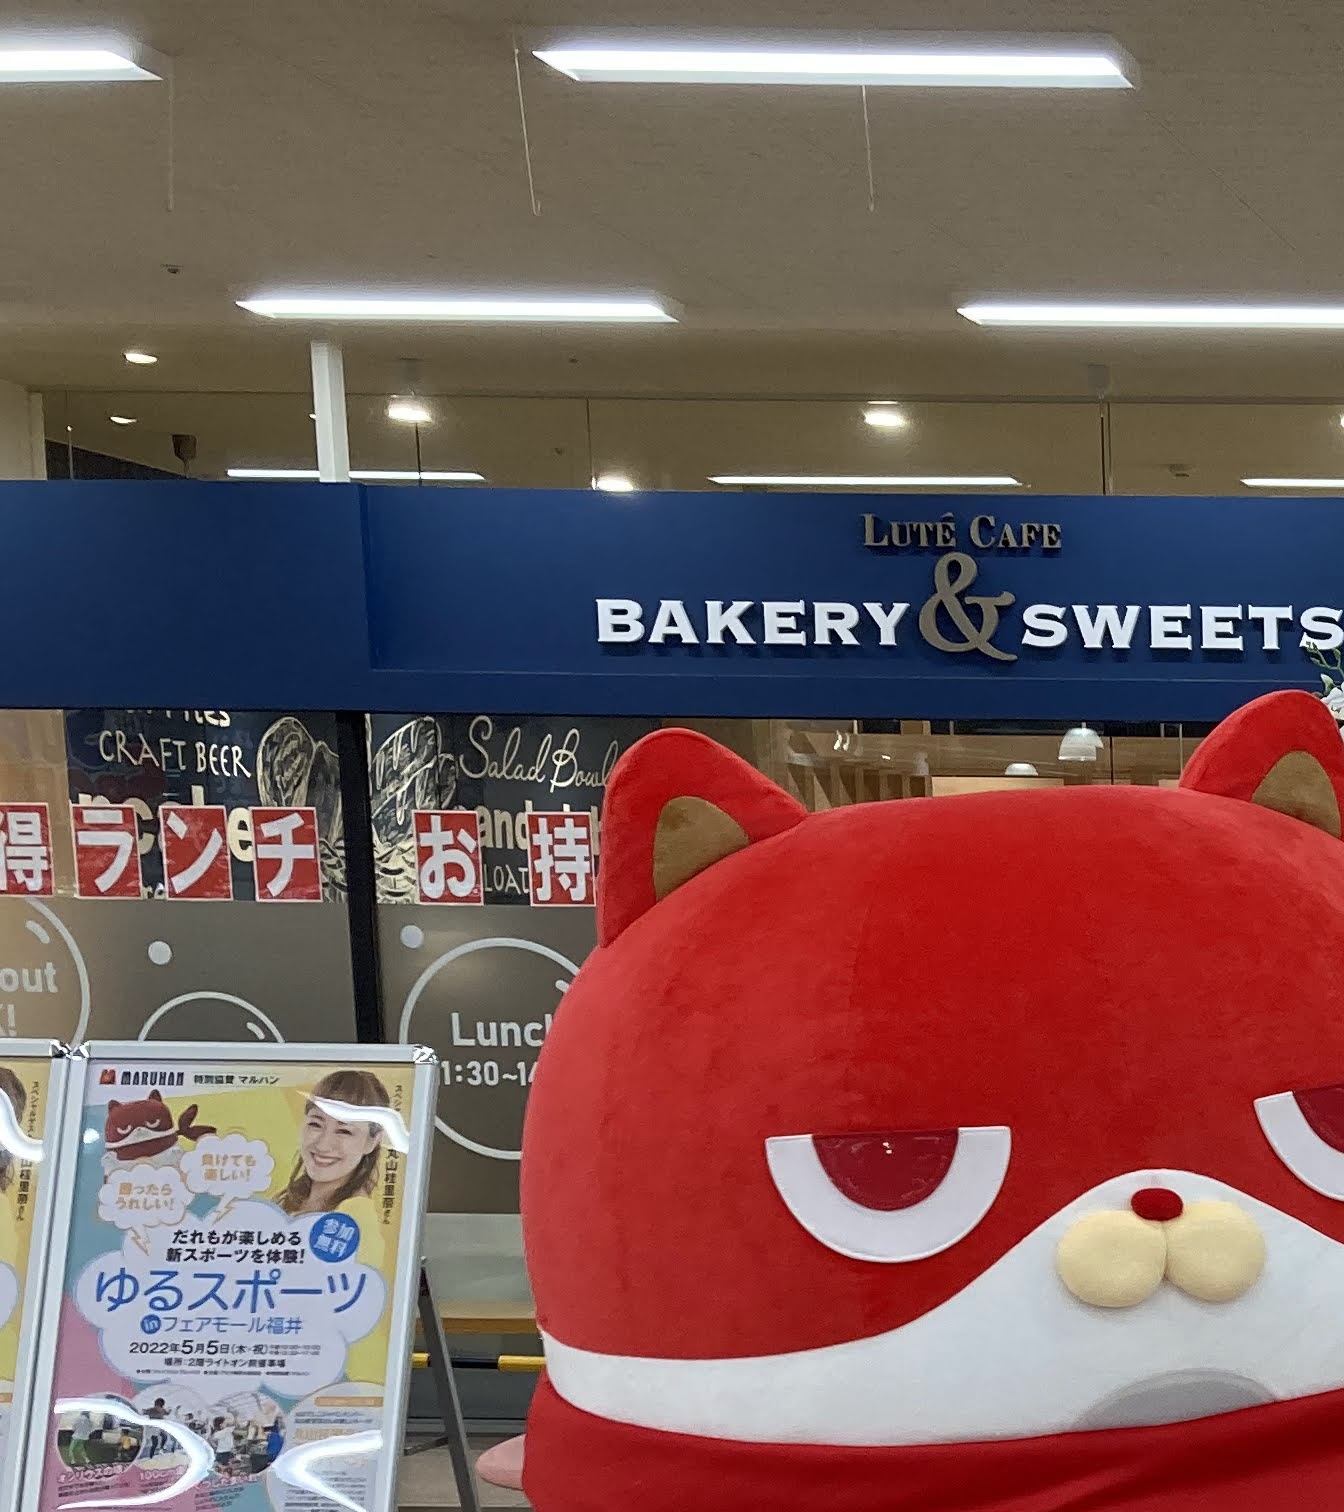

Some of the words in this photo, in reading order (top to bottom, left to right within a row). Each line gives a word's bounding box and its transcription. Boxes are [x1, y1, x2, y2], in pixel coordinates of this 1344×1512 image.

[970, 515, 1063, 550] CAFE
[596, 598, 910, 647] BAKERY
[919, 552, 1019, 662] &
[1021, 603, 1344, 652] SWEETS
[99, 729, 186, 772] CRAFT
[195, 741, 251, 779] BEER
[459, 715, 552, 783] Salad
[551, 727, 619, 793] Bowl
[120, 1070, 184, 1086] MARUHAN
[239, 1075, 280, 1086] マルハン
[172, 1229, 302, 1247] だれもが楽しめる
[96, 1267, 368, 1314] ゆるスポーツ
[163, 1316, 304, 1336] フェアモール福井
